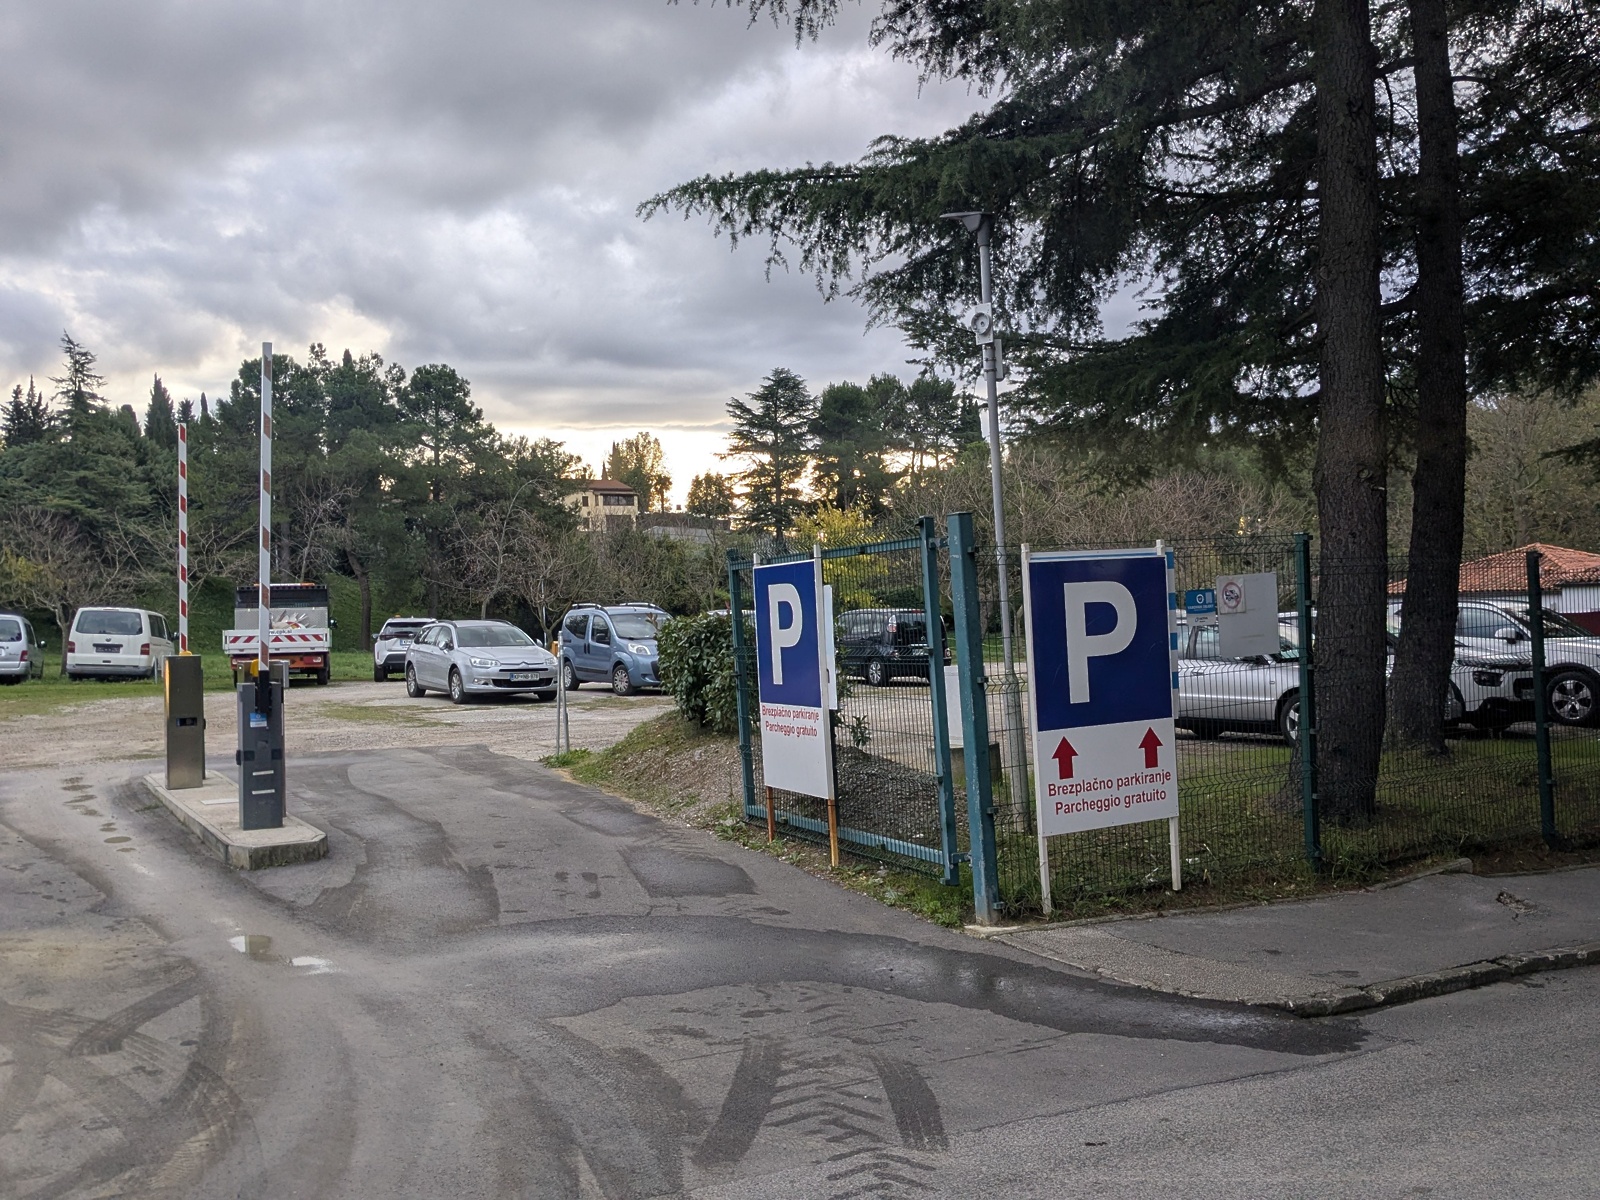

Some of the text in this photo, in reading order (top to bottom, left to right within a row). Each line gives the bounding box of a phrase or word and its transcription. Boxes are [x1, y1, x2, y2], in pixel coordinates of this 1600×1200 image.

[768, 583, 803, 685] P
[1064, 581, 1137, 704] P
[762, 705, 820, 723] Brezplačno parkiranje
[765, 720, 818, 738] Parcheggio gratuito
[1048, 769, 1172, 797] Brezplačno parkiranje
[1055, 788, 1167, 815] Parcheggio gratuito
